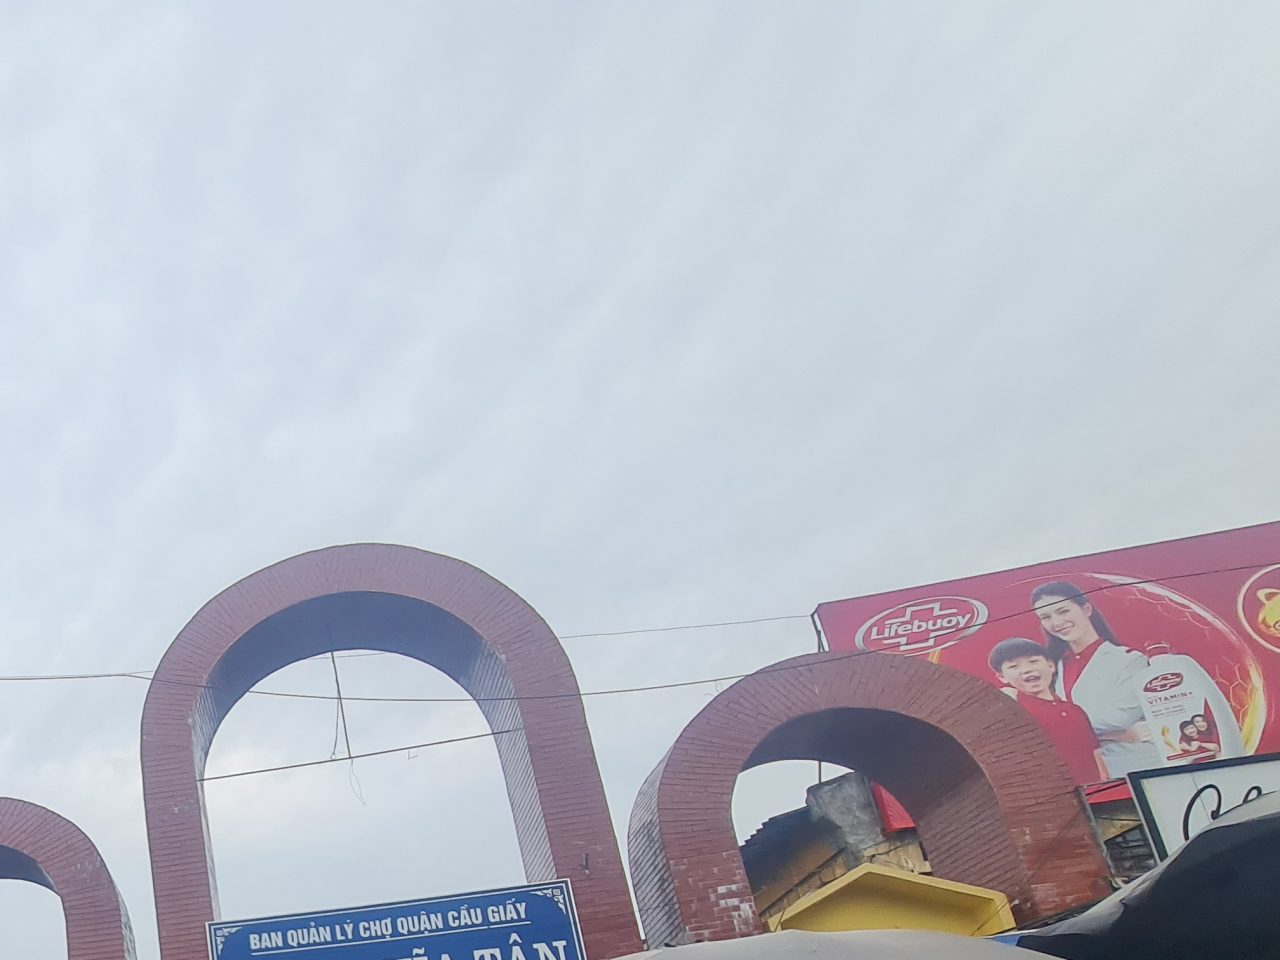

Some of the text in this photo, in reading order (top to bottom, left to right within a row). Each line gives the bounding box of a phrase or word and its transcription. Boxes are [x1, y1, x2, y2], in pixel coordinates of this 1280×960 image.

[870, 614, 972, 640] Lifebuoy
[249, 898, 526, 950] BAN QUẢN LÝ CHỢ QUẬN CẦU GIẤY
